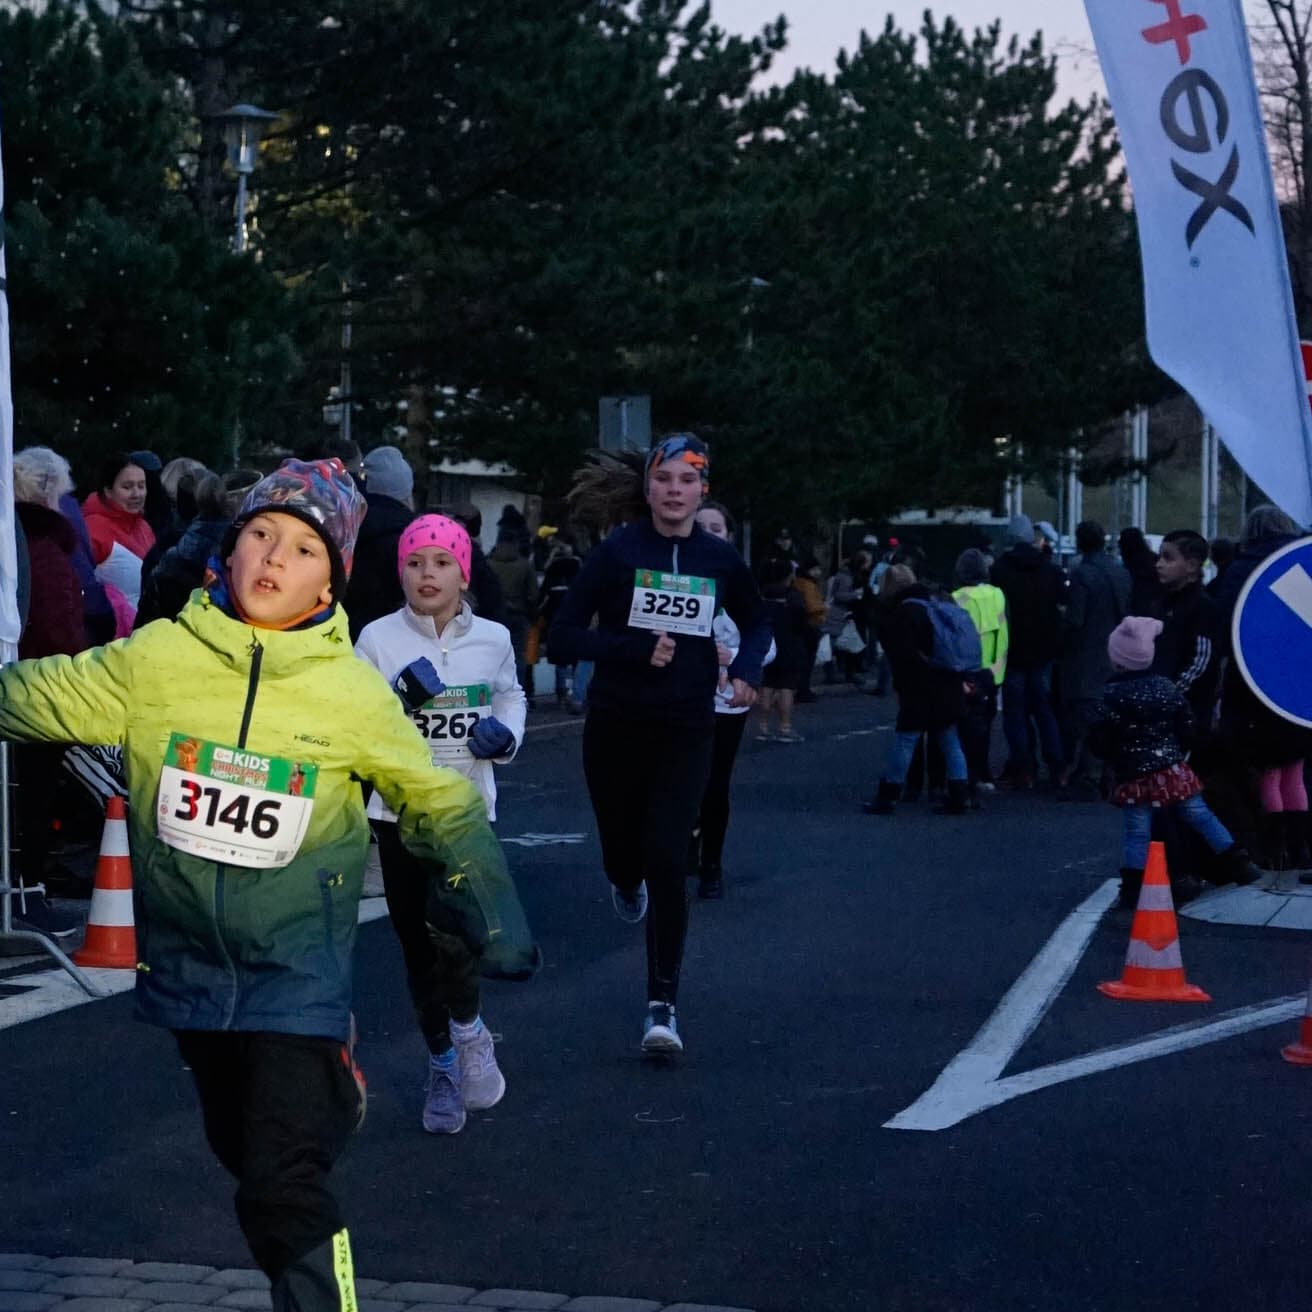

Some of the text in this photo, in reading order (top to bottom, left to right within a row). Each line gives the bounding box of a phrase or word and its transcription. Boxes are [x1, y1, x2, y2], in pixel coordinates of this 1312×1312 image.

[642, 592, 700, 619] 3259
[234, 751, 270, 771] KIDS
[175, 779, 282, 839] 3146
